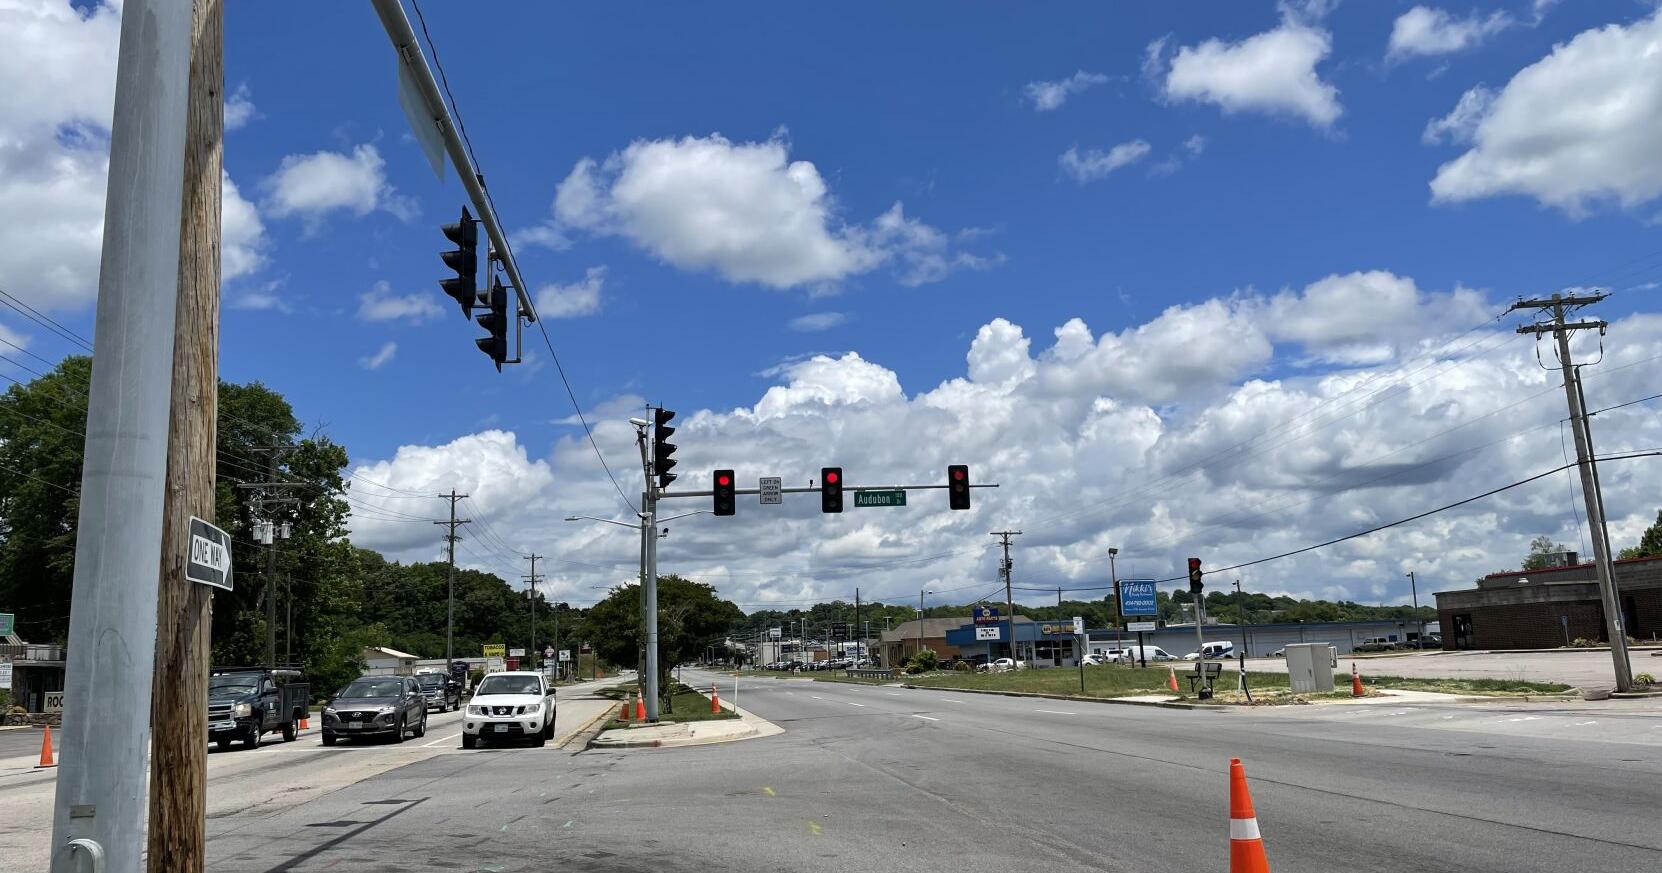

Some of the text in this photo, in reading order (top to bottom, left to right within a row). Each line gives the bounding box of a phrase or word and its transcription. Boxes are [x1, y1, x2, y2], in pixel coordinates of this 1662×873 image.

[858, 494, 891, 505] Audubon
[194, 538, 223, 568] ONE WAY
[1123, 582, 1153, 598] Nikki's
